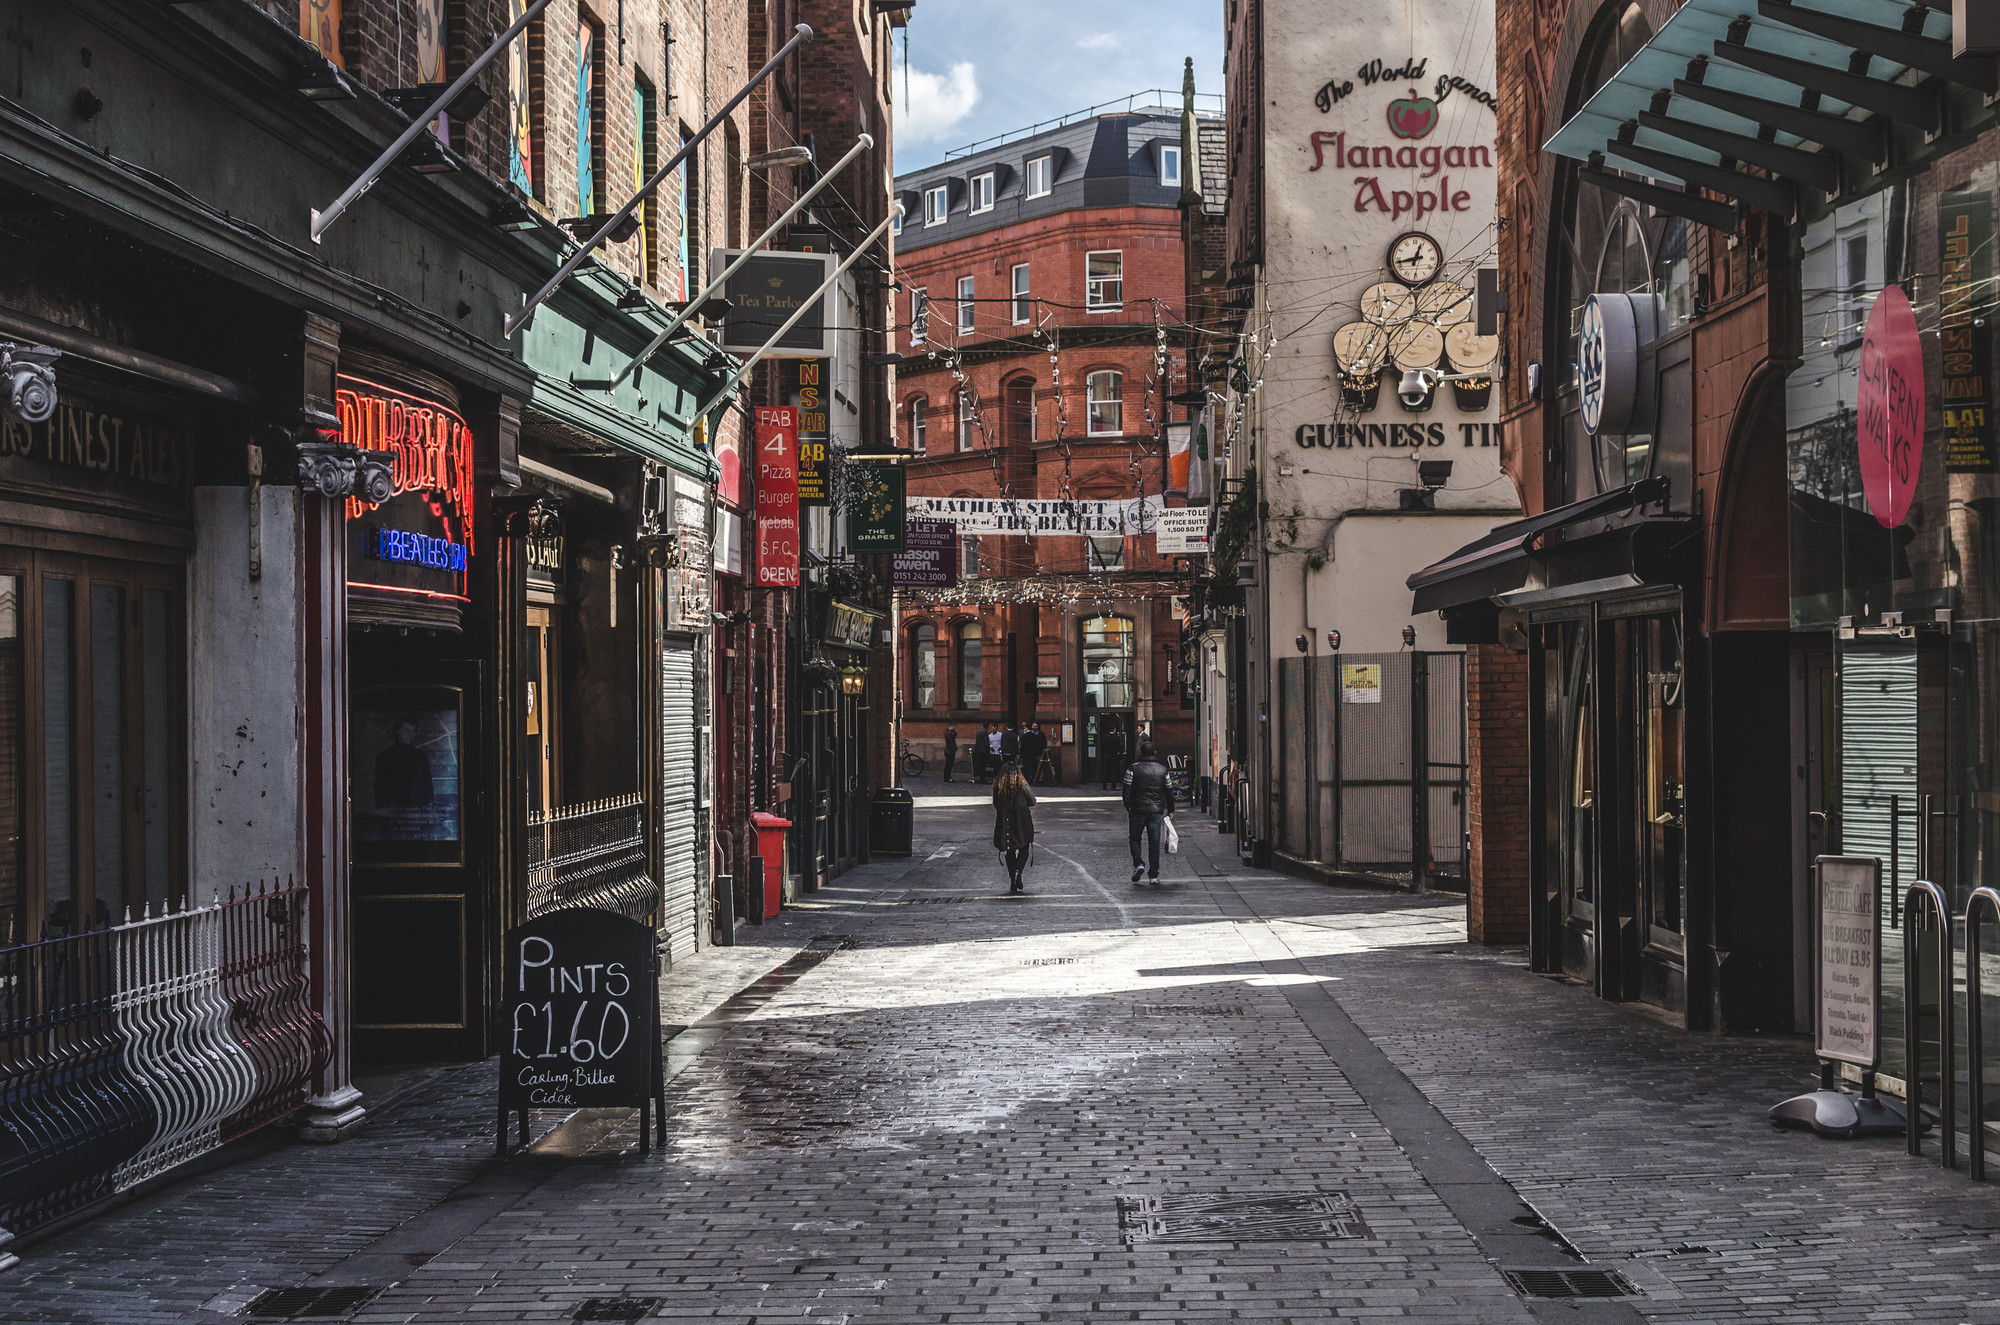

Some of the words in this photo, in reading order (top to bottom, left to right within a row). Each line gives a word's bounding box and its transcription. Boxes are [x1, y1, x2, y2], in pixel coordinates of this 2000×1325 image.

[1314, 79, 1354, 113] The
[1358, 57, 1428, 87] World
[1353, 175, 1471, 221] Apple
[737, 293, 760, 308] Tea
[765, 294, 805, 310] Parlo
[1454, 378, 1491, 391] GUINNESS
[1862, 337, 1920, 438] CAVERN
[760, 410, 791, 427] FAB
[763, 432, 788, 456] 4
[1295, 421, 1446, 449] GUINNESS
[1459, 422, 1500, 447] TI
[1864, 389, 1912, 485] WALKS
[799, 443, 825, 462] AB
[761, 463, 792, 479] Pizza
[758, 489, 794, 507] Burger
[759, 515, 795, 530] Kebab
[915, 523, 938, 533] LET
[388, 529, 449, 569] BEATLES
[760, 566, 795, 582] OPEN
[893, 571, 911, 580] 0151
[912, 572, 927, 581] 242
[928, 573, 947, 581] 3000
[1823, 925, 1834, 941] BIG
[1834, 926, 1872, 945] BREAKFAST
[1850, 948, 1871, 968] £3.95
[512, 1000, 630, 1063] £1.60
[1829, 1025, 1842, 1037] Black
[1842, 1027, 1865, 1044] Pudding
[573, 1066, 617, 1086] Bitter
